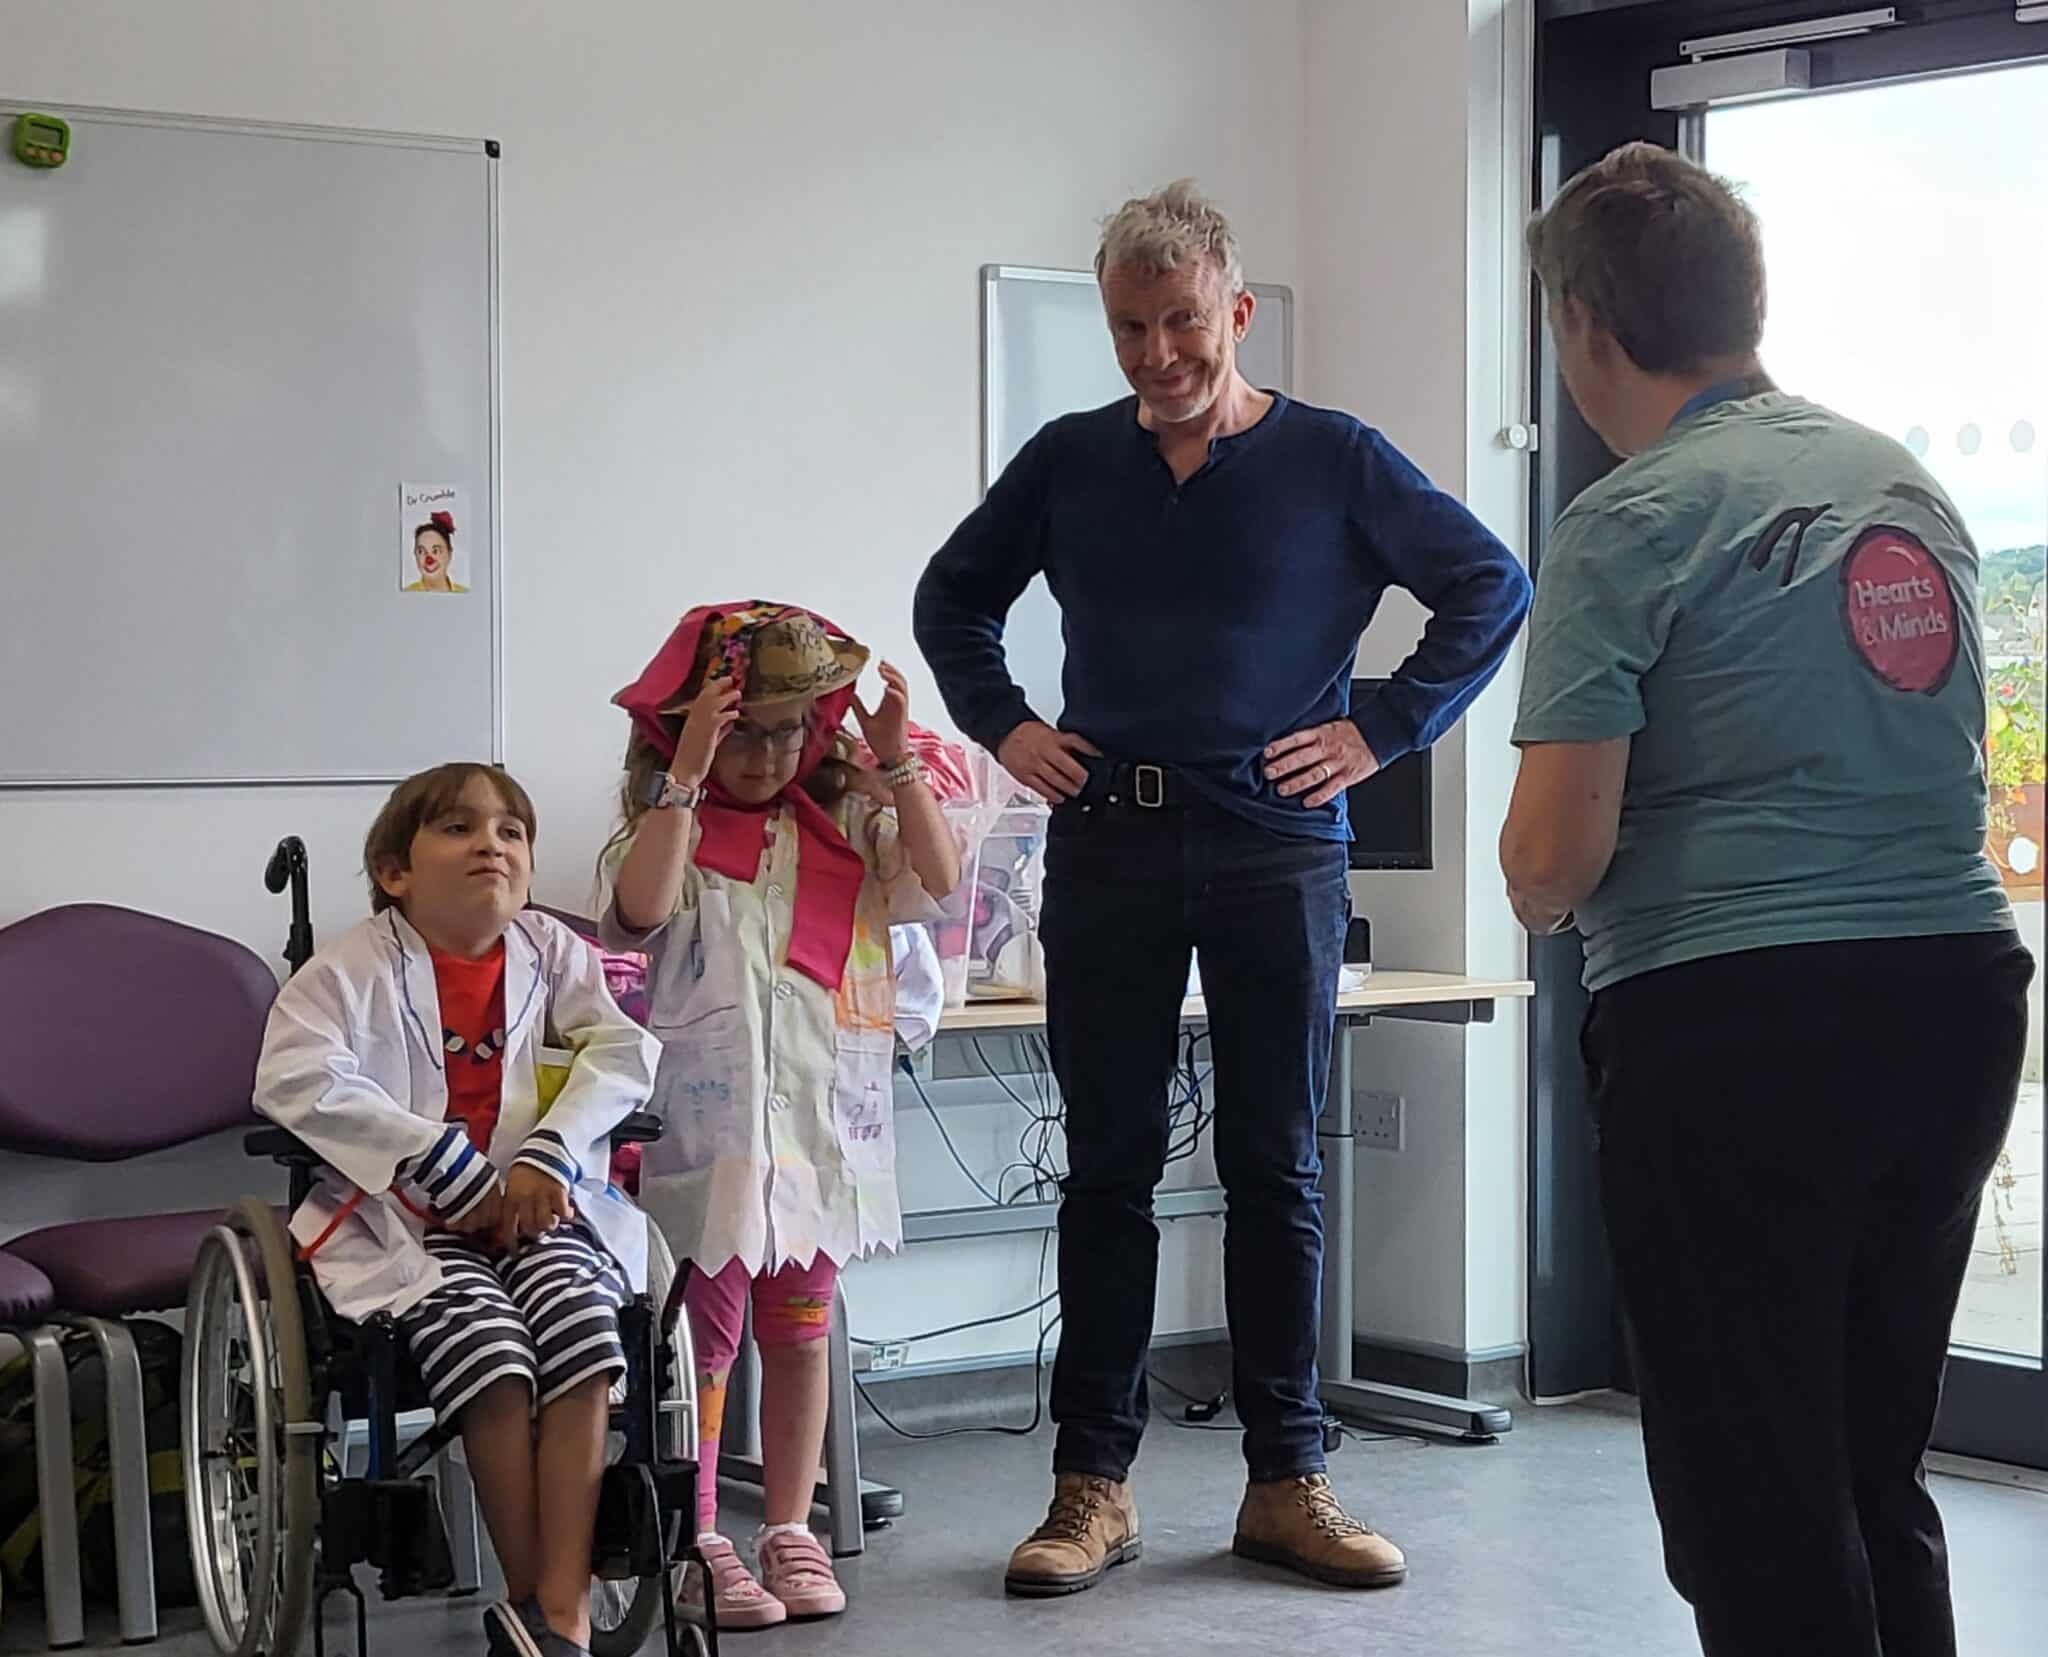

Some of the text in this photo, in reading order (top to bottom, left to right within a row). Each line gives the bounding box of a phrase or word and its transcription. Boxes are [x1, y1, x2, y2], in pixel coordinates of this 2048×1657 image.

[406, 495, 418, 506] Dr
[1855, 575, 1934, 609] Hearts
[1861, 607, 1947, 646] & Minds
